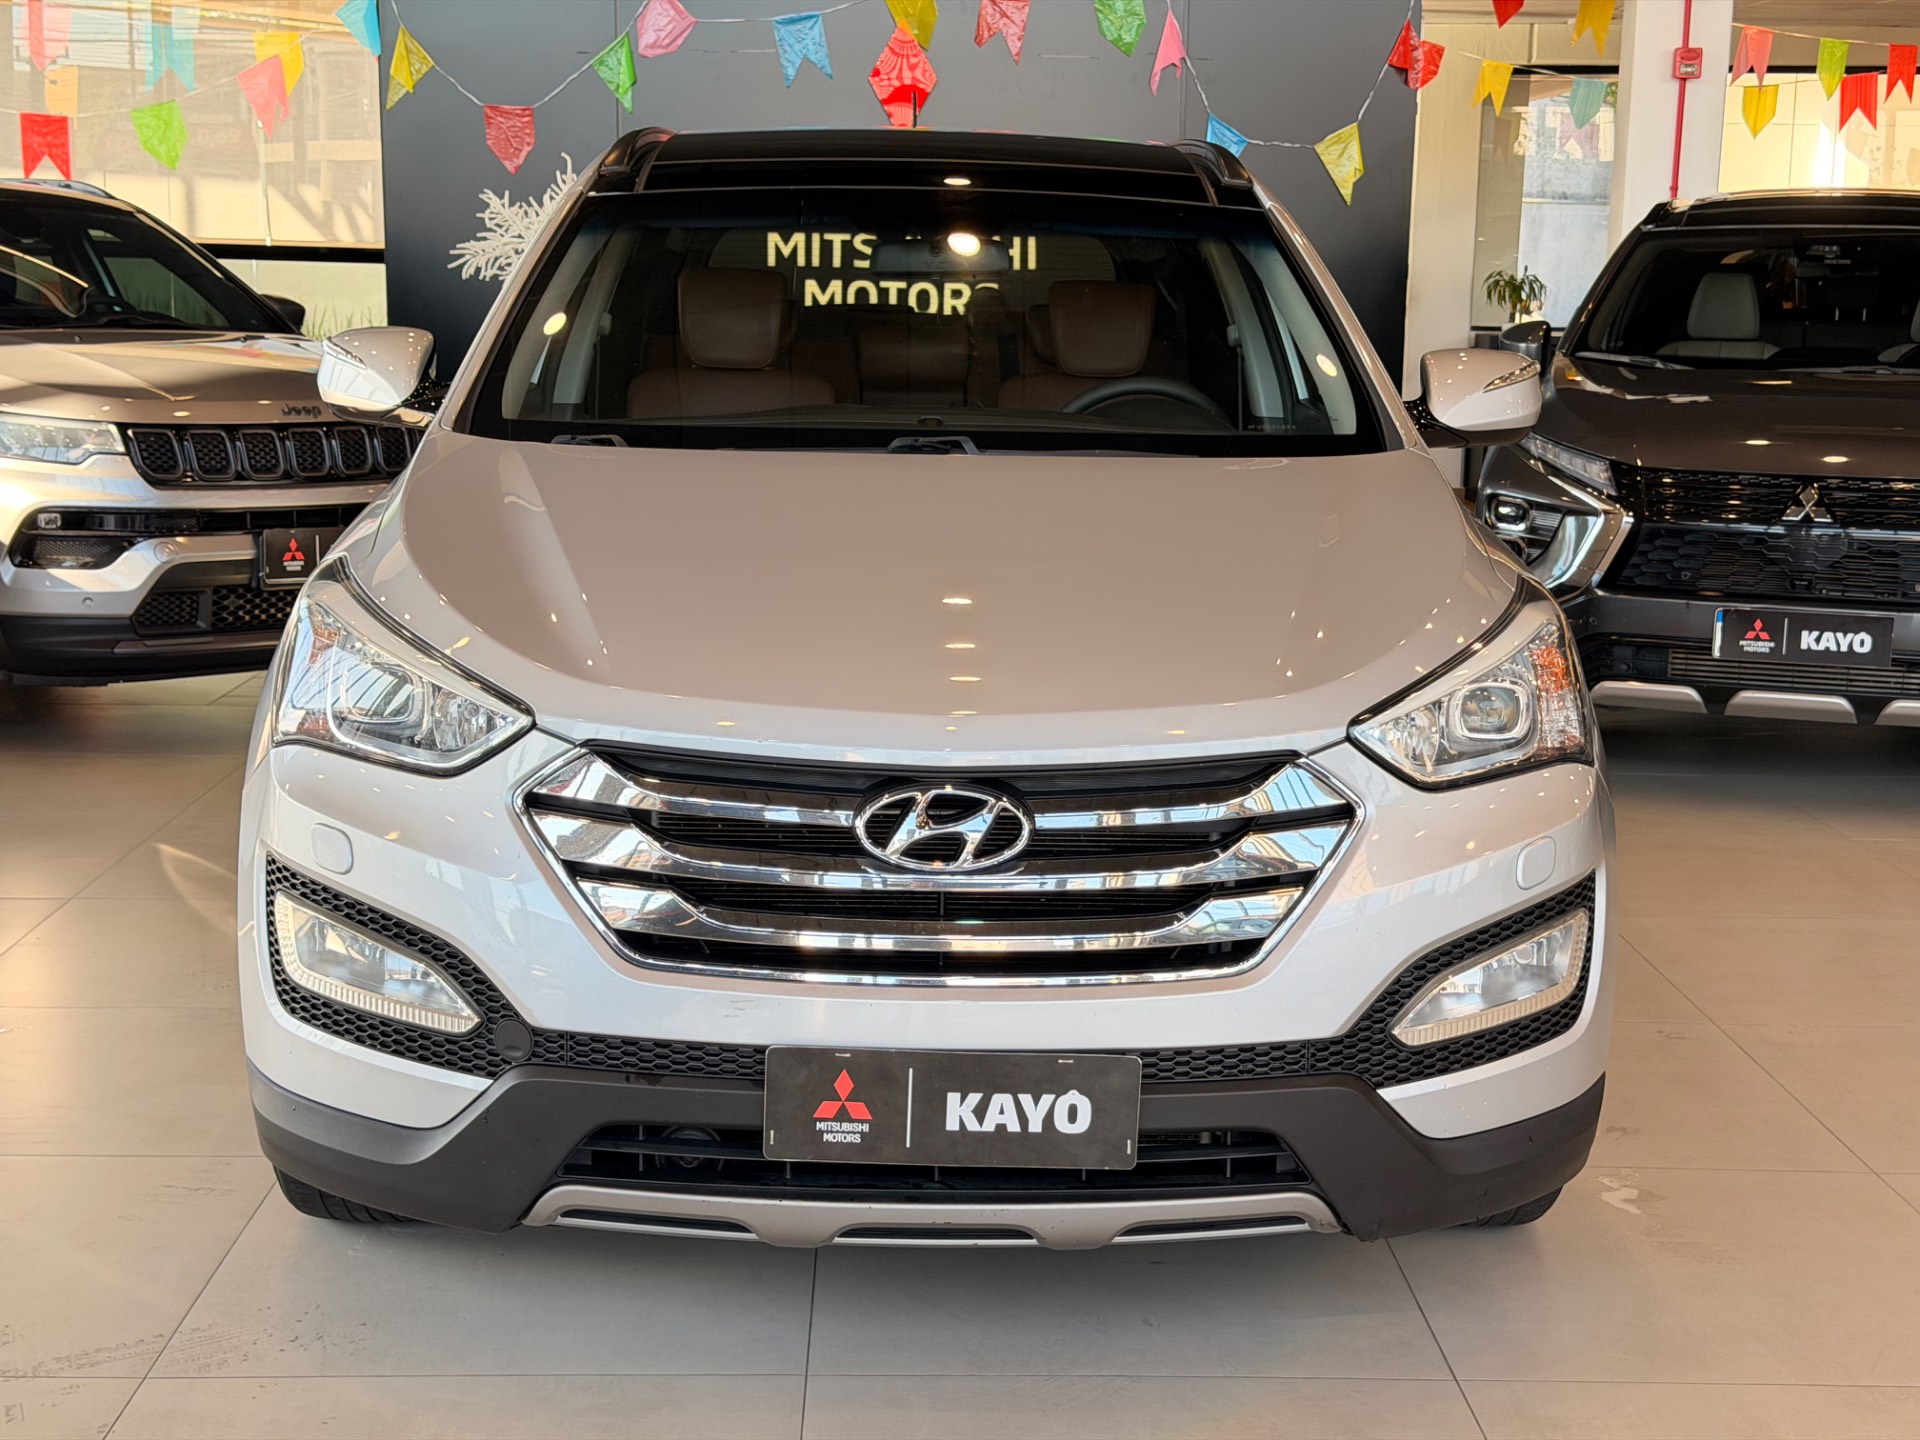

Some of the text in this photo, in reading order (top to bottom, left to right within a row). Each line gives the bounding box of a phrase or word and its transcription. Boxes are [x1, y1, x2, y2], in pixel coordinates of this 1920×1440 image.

[804, 279, 999, 316] MOTOR
[281, 402, 322, 419] Jeep
[1738, 640, 1775, 648] MITSUBISHI
[945, 1089, 1093, 1134] KAYÔ
[815, 1121, 870, 1132] MITSUBISHI
[823, 1132, 861, 1143] MOTORS
